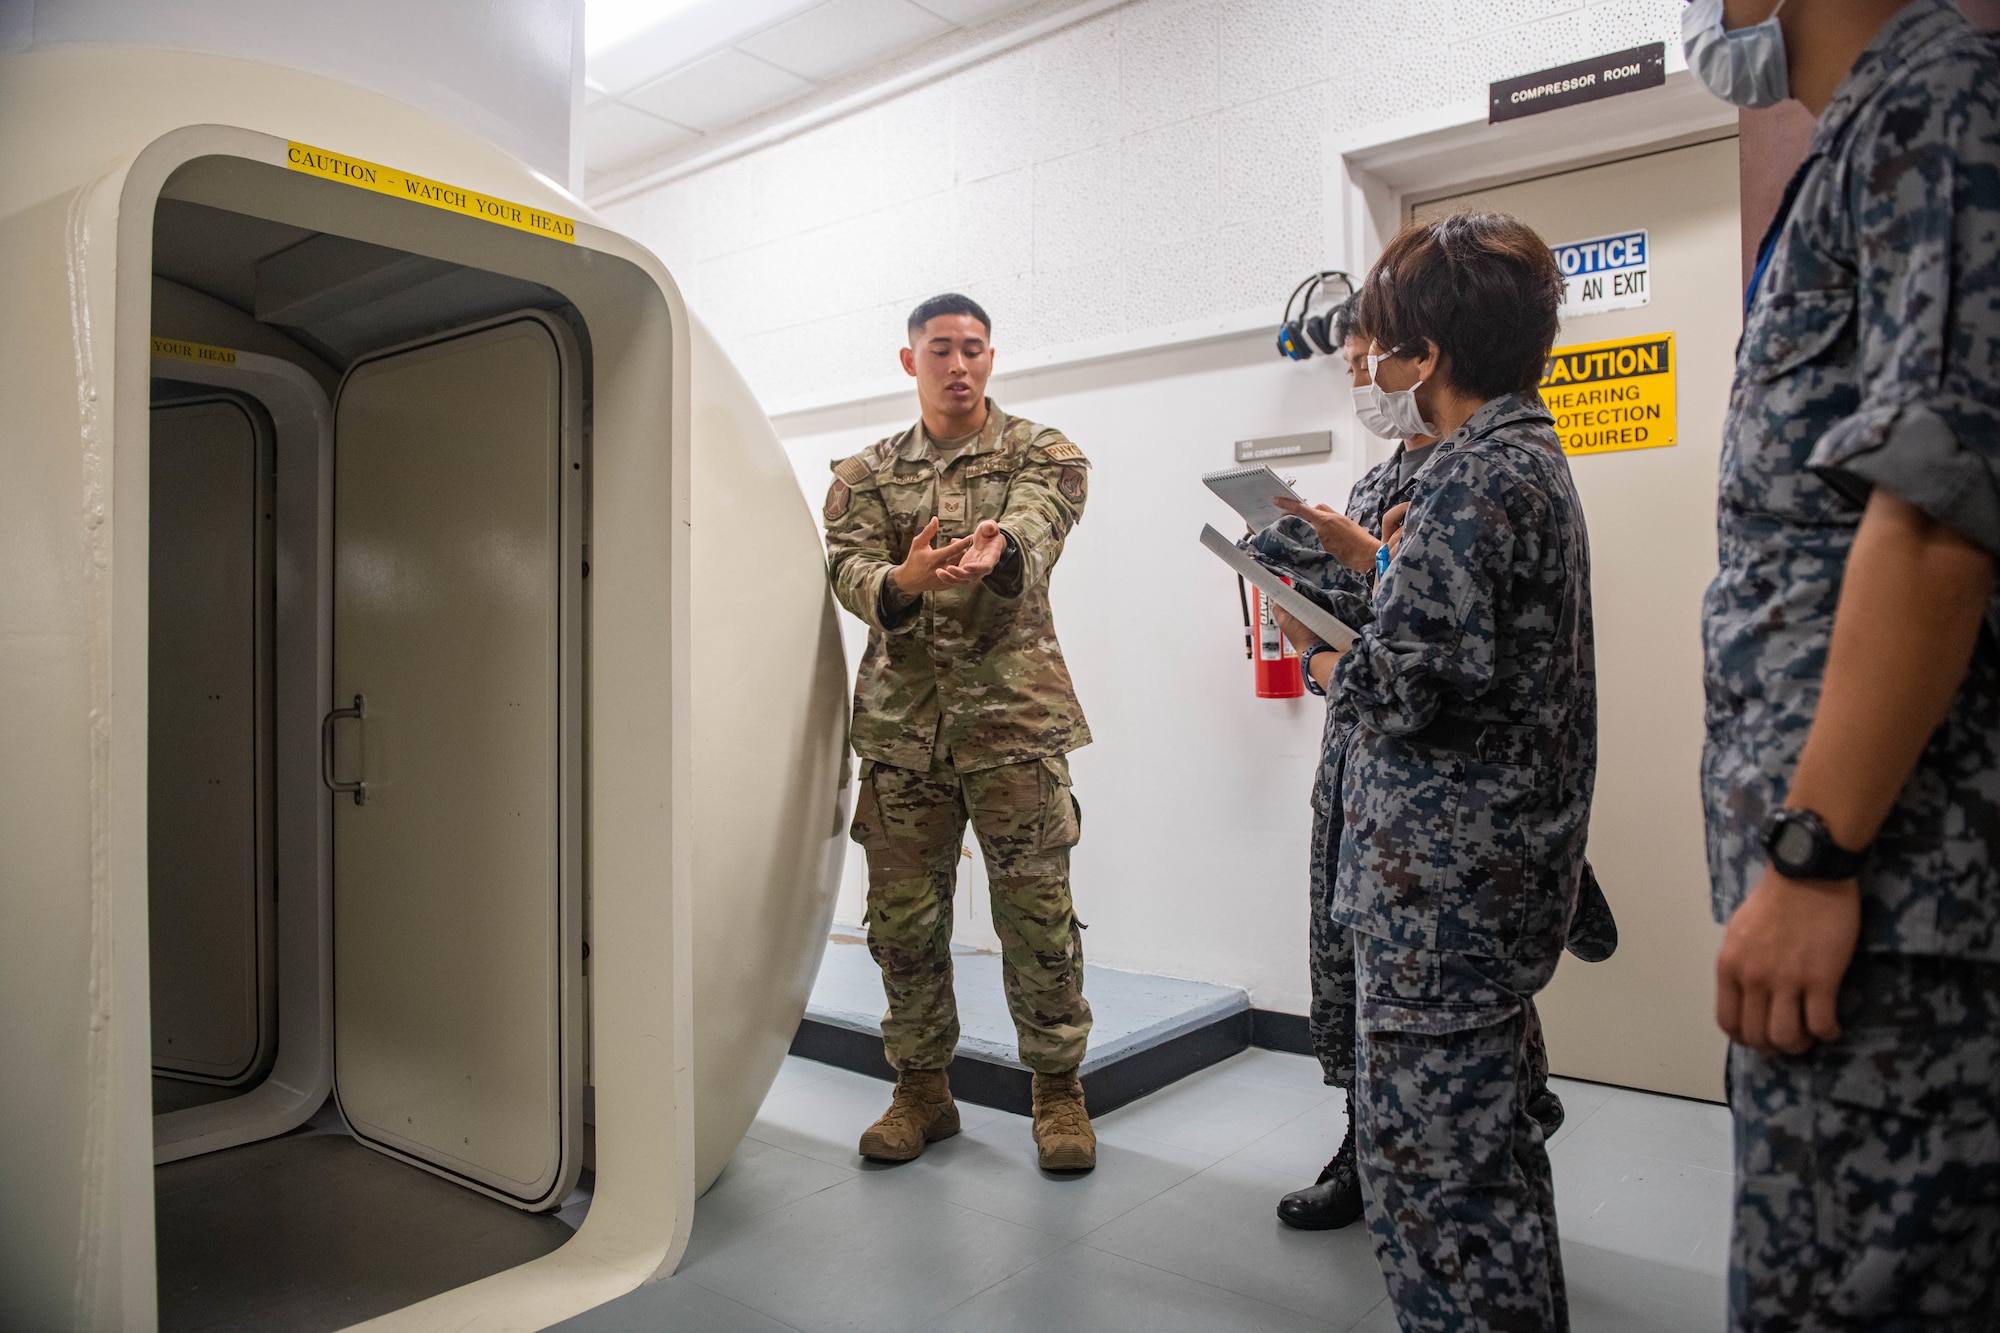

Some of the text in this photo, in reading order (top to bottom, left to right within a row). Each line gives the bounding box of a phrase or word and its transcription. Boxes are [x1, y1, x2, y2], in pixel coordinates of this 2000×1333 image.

[1511, 62, 1641, 104] COMPRESSOR ROOM
[288, 147, 377, 184] CAUTION
[405, 178, 466, 209] WATCH
[476, 198, 522, 224] YOUR
[530, 212, 574, 237] HEAD
[1582, 277, 1603, 302] AN
[1614, 270, 1647, 297] EXIT
[154, 341, 236, 363] YOUR HEAD
[1549, 385, 1640, 409] HEARING
[1556, 404, 1661, 429] OTECTION
[1560, 427, 1649, 449] EQUIRED
